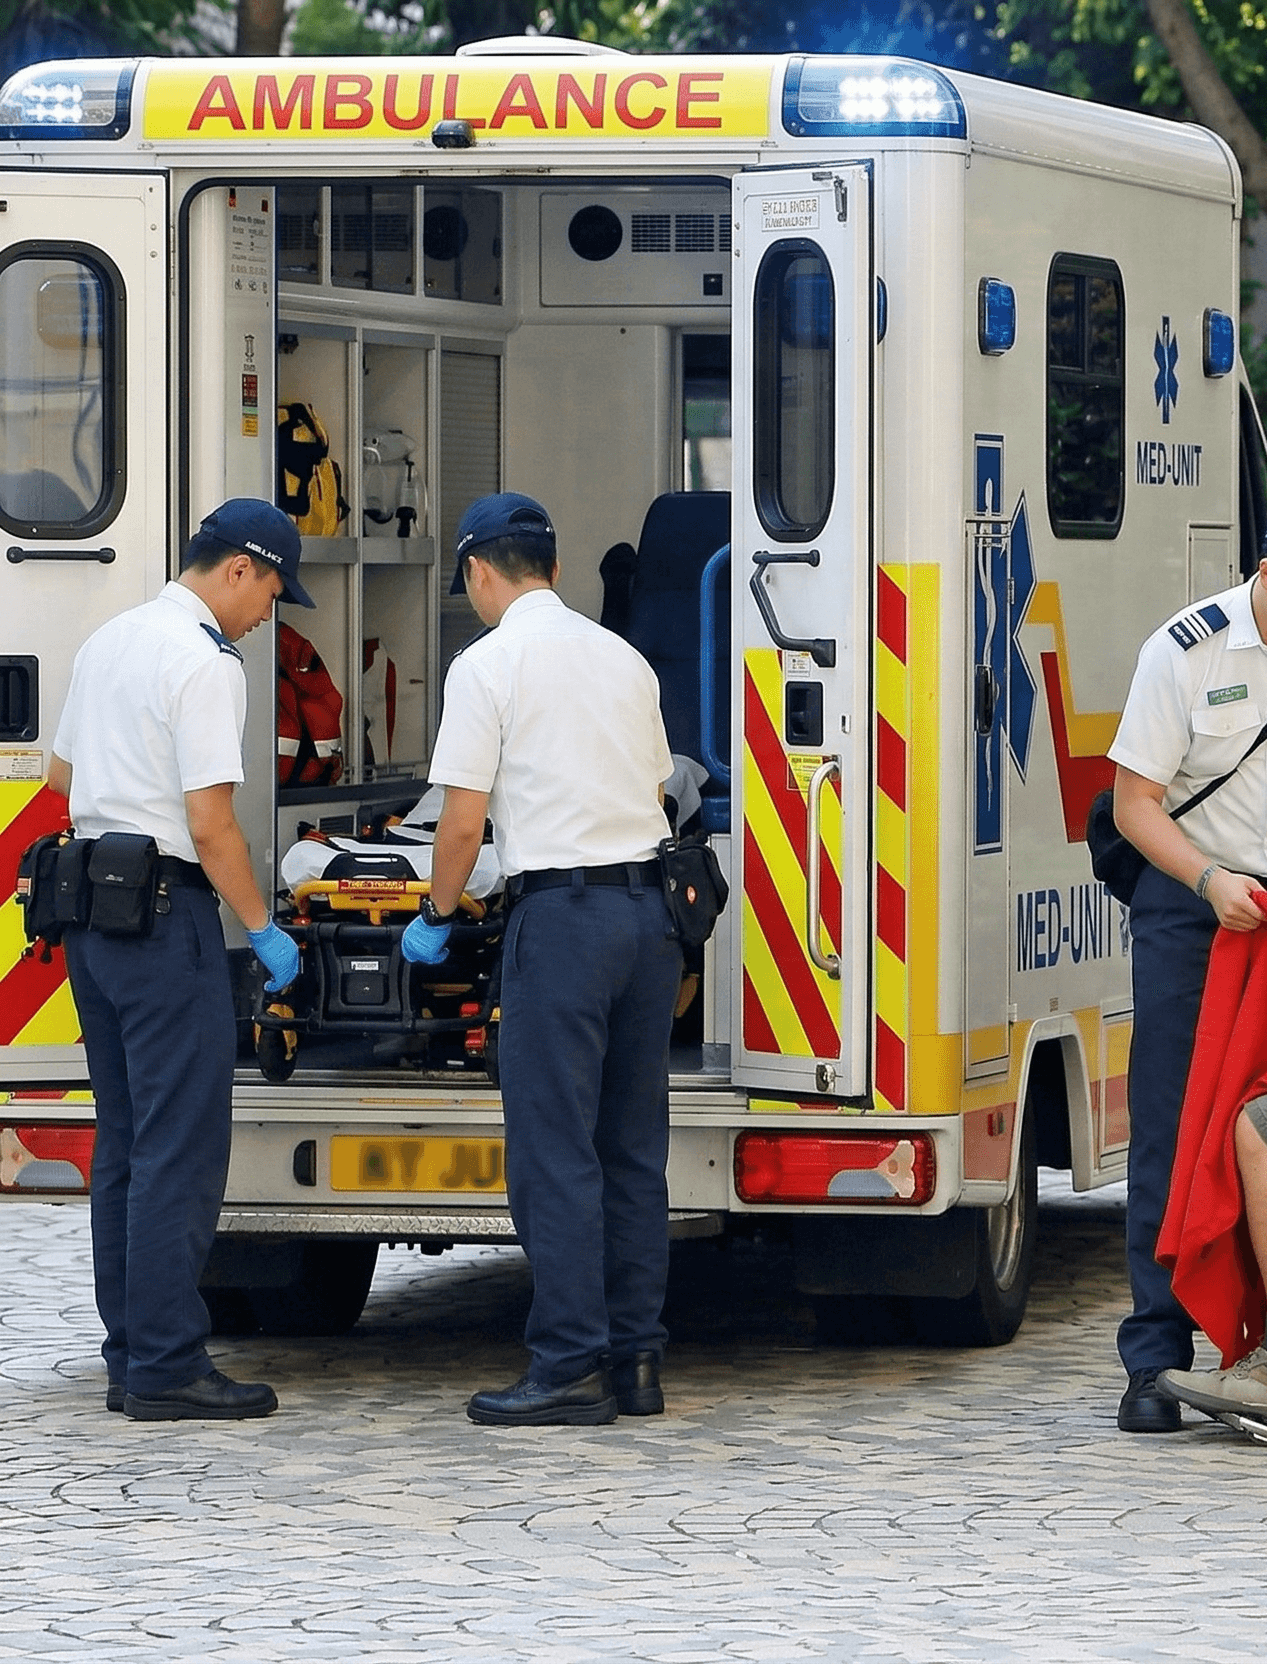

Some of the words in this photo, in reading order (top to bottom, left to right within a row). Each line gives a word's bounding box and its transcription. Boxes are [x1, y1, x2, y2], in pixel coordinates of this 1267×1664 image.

[186, 72, 725, 132] AMBULANCE
[1136, 441, 1203, 487] MED-UNIT
[1017, 883, 1112, 973] MED-UNIT
